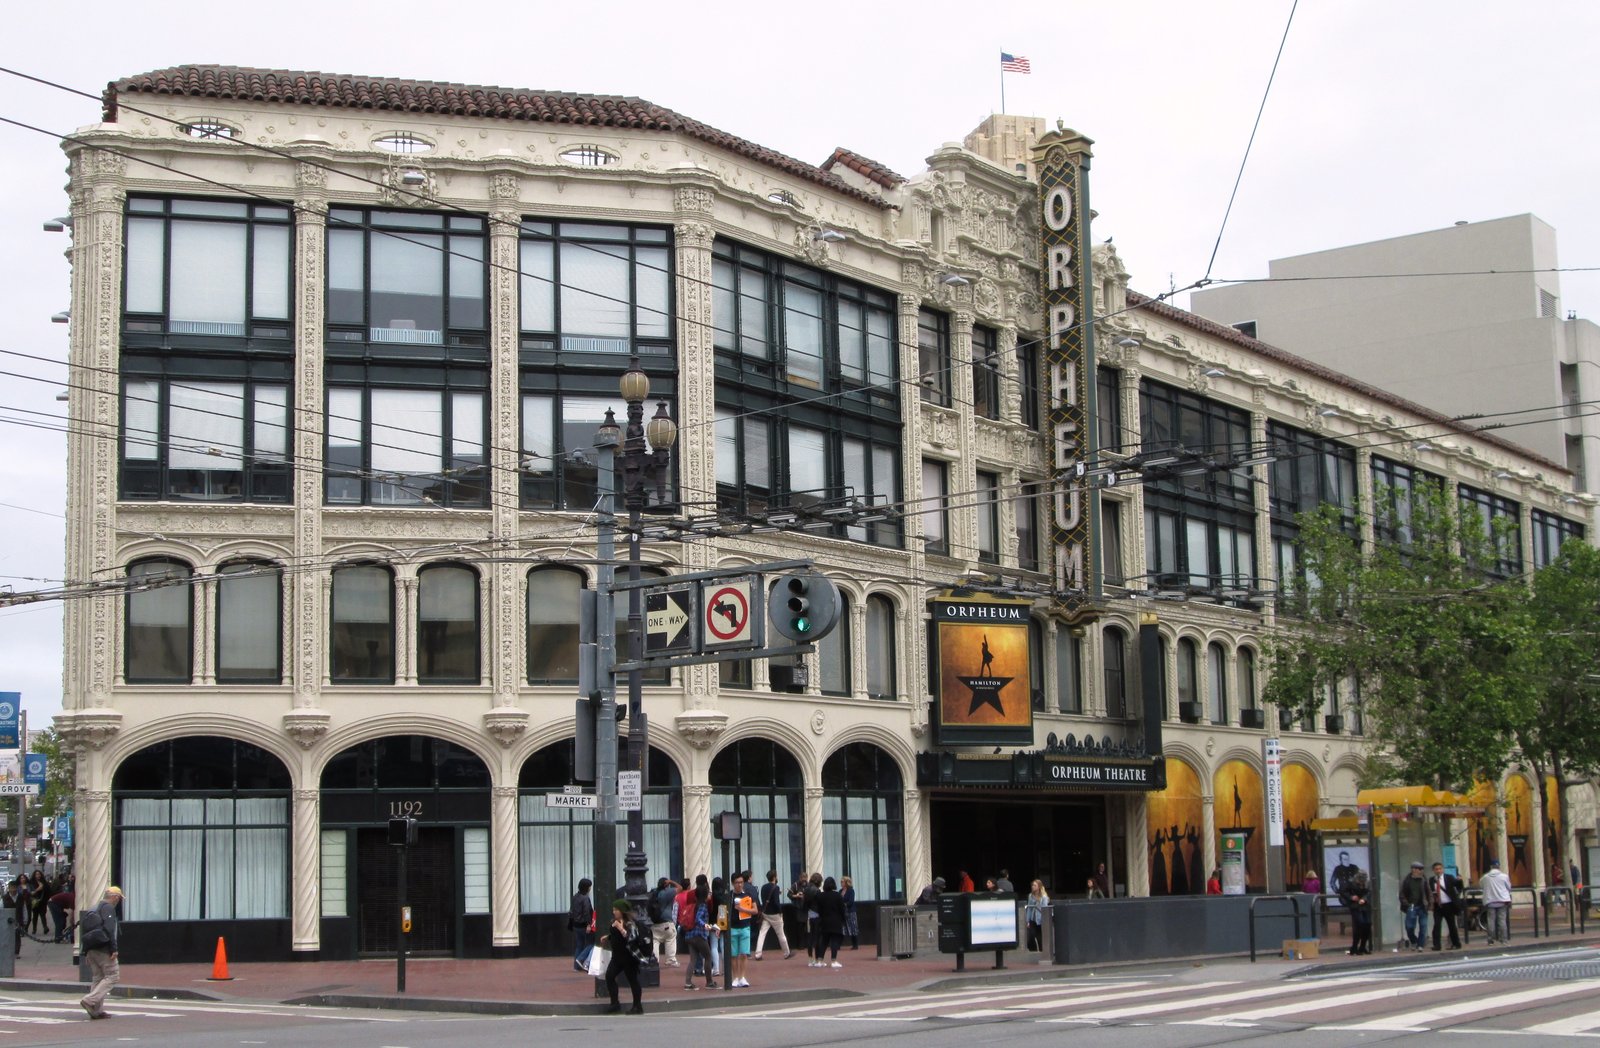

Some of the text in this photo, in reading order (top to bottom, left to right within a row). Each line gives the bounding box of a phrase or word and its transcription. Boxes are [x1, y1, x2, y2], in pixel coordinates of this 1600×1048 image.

[1044, 185, 1083, 591] ORPHEUM
[946, 605, 1021, 619] ORPHEUM
[648, 615, 685, 627] ONE WAY
[1052, 765, 1147, 781] ORPHEUM THEATRE
[1, 785, 32, 793] GROVE
[389, 800, 424, 816] 1192
[555, 796, 592, 806] MARKET
[1268, 778, 1277, 824] Civic Center
